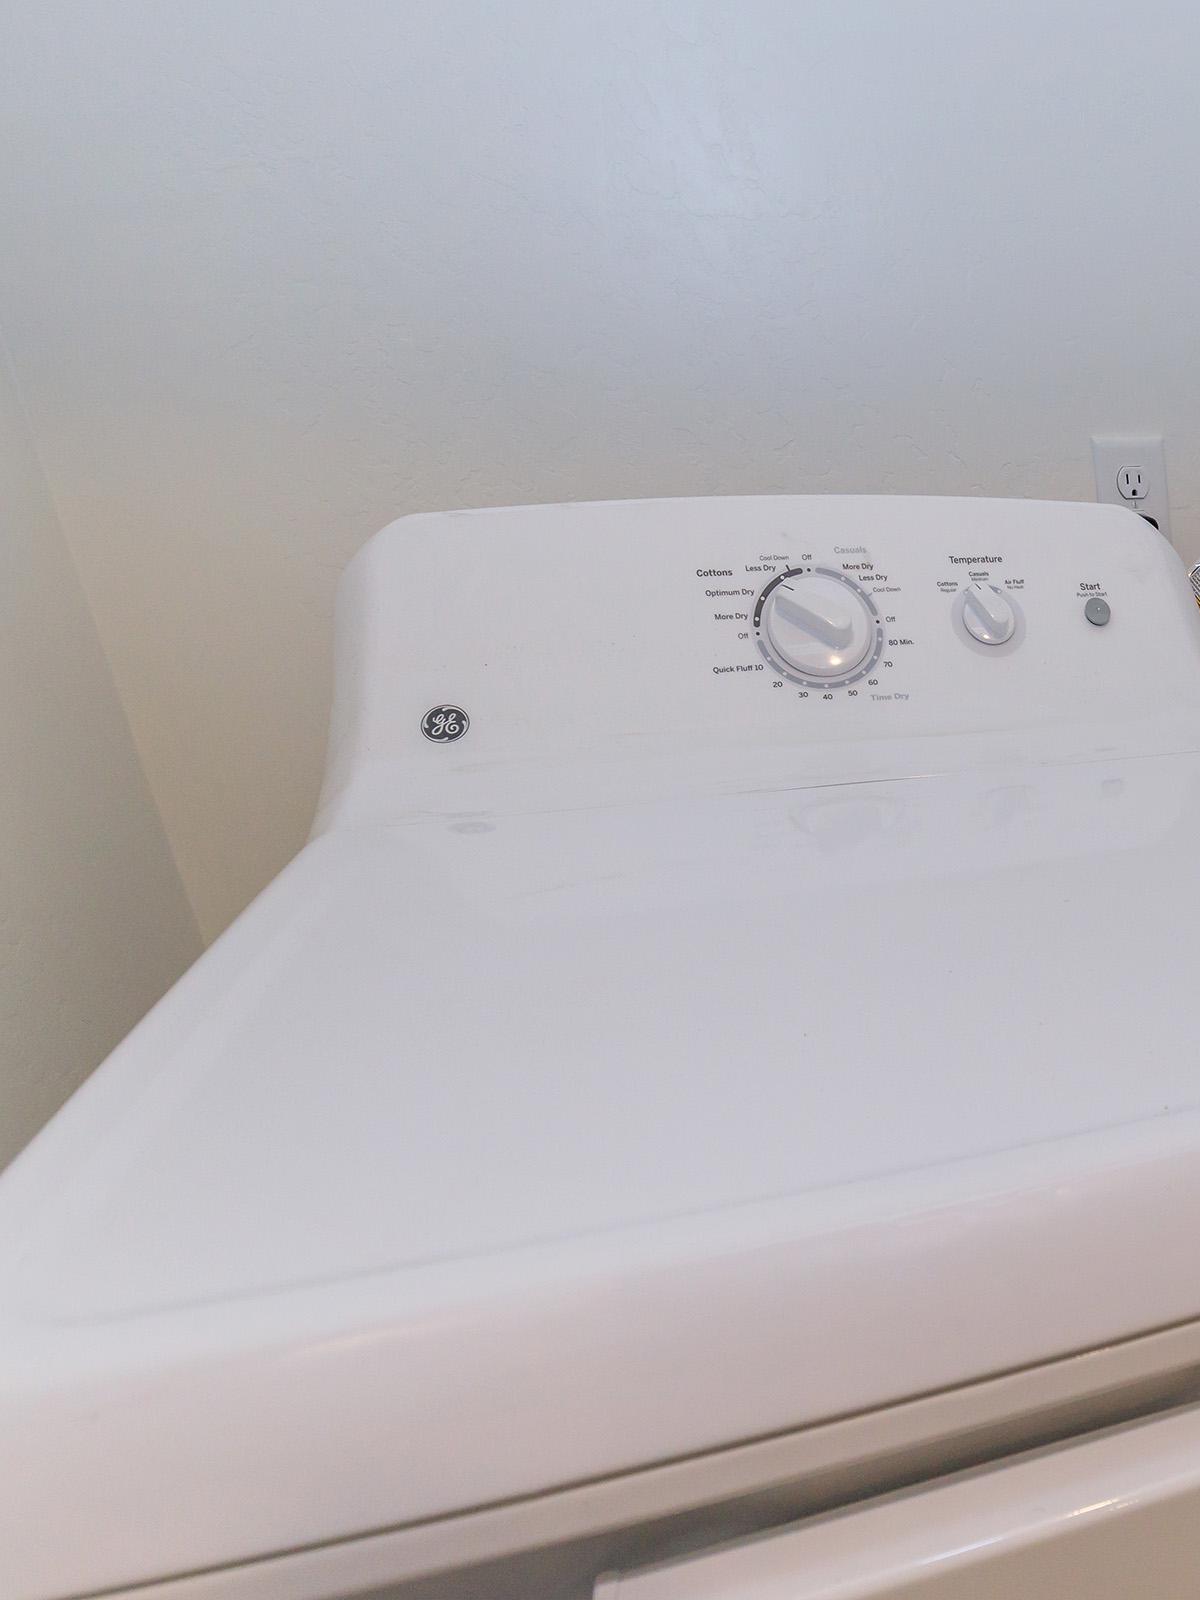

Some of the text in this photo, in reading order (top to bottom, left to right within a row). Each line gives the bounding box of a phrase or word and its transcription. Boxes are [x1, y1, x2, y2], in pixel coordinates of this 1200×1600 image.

[834, 546, 867, 554] Casuals
[949, 556, 1002, 565] Temperature
[696, 569, 733, 577] Cottons
[876, 574, 887, 582] Dry
[706, 588, 755, 597] Optimum Dry
[735, 613, 748, 621] Dry
[713, 665, 735, 673] Quick
